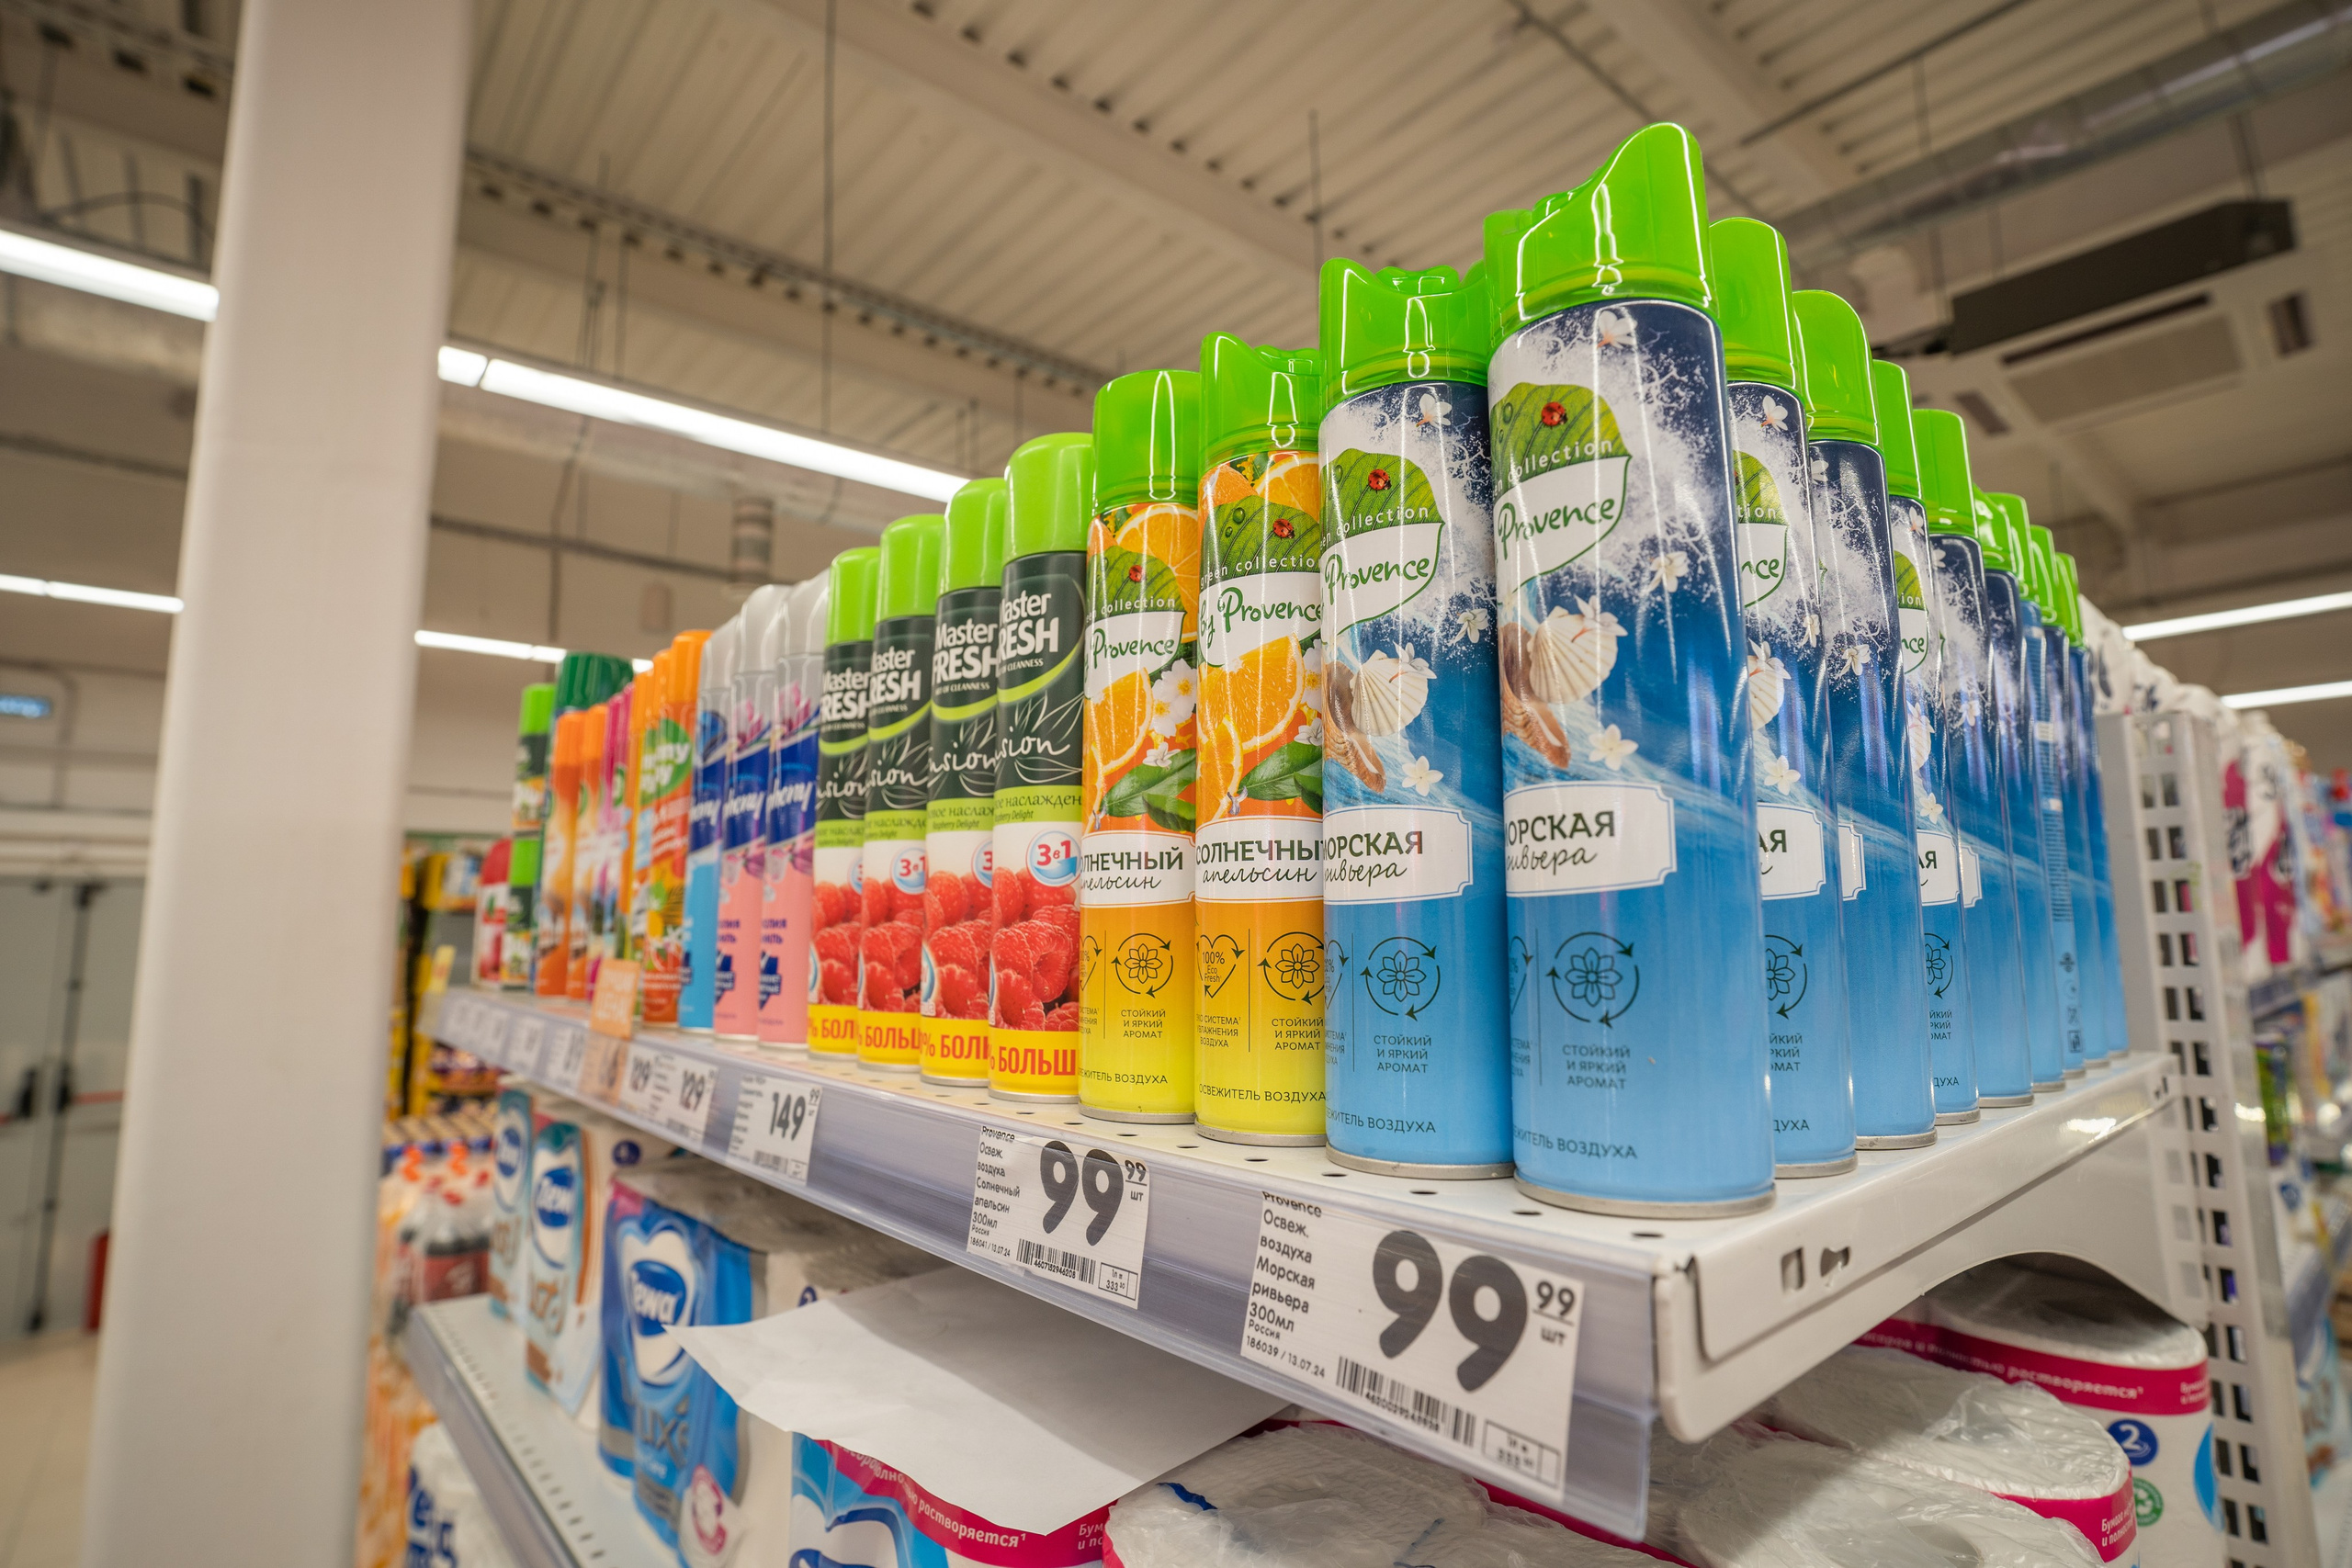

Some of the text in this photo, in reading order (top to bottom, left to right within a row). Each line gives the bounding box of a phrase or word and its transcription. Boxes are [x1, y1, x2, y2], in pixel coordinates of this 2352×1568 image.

[1508, 440, 1612, 482] collection
[1337, 506, 1429, 536] collection
[1498, 498, 1615, 560] Provence
[1236, 554, 1315, 572] collectio
[1324, 554, 1430, 605] Provence
[1101, 596, 1176, 615] collection
[934, 617, 999, 652] Master
[998, 616, 1059, 661] RESH
[1091, 628, 1175, 670] Provence
[869, 670, 922, 705] RESH
[1006, 794, 1082, 808] наслажден
[1506, 810, 1615, 846] ОРСКАЯ
[1081, 846, 1183, 873] ЛНЕЧНЫЙ
[1196, 840, 1323, 865] СОЛНЕЧНЫ
[1203, 867, 1317, 884] апельсин
[1202, 951, 1226, 964] 100%
[1206, 965, 1218, 975] Eco
[1120, 1009, 1166, 1018] СТОЙКИЙ
[1272, 1016, 1324, 1027] СТОЙКИЙ
[1929, 1010, 1952, 1019] ЙКИЙ
[821, 1018, 854, 1040] БОЛ
[1123, 1020, 1163, 1028] И ЯРКИЙ
[1123, 1030, 1163, 1039] АРОМАТ
[1200, 1036, 1229, 1048] ВОЗДУХА
[1274, 1028, 1321, 1039] И ЯРКИЙ
[1374, 1034, 1432, 1046] СТОЙКИЙ
[1770, 1032, 1803, 1044] ЙКИЙ
[1274, 1042, 1321, 1050] АРОМАТ
[1377, 1048, 1429, 1060] И ЯРКИЙ
[1562, 1044, 1631, 1058] СТОЙКИЙ
[998, 1046, 1076, 1076] БОЛЬШ
[1376, 1062, 1429, 1073] АРОМАТ
[1566, 1061, 1626, 1074] И ЯРКИЙ
[1114, 1073, 1168, 1085] ВОЗДУХА
[1566, 1075, 1626, 1089] АРОМАТ
[1933, 1077, 1960, 1089] ДУХА
[1198, 1083, 1326, 1104] ОСВЕЖИТЕЛЬ ВОЗДУХА
[770, 1091, 807, 1141] 149
[982, 1125, 1015, 1144] Provence
[1367, 1117, 1436, 1134] ВОЗДУХА
[1773, 1119, 1810, 1134] ДУХА
[979, 1142, 1003, 1159] Освеж.
[1556, 1138, 1638, 1159] ВОЗДУХА
[977, 1161, 1006, 1177] воздуха
[976, 1176, 1020, 1198] Солнечный
[1040, 1140, 1147, 1247] 99 99
[1130, 1190, 1144, 1201] шт
[974, 1196, 1010, 1213] апельсин
[1261, 1190, 1322, 1218] Provence
[972, 1212, 998, 1229] 300мл
[1263, 1208, 1309, 1238] Освеж.
[971, 1224, 989, 1236] Россия
[970, 1236, 988, 1249] 186041
[991, 1243, 1011, 1257] 13.07.24
[1260, 1235, 1312, 1264] воздуха
[1256, 1255, 1316, 1290] Морская
[1105, 1280, 1119, 1292] 333
[1251, 1281, 1309, 1314] ривьера
[1250, 1302, 1295, 1333] 300мл
[1373, 1230, 1575, 1394] 99 99
[1249, 1319, 1281, 1340] Россия
[1541, 1326, 1566, 1348] шт
[1247, 1336, 1279, 1357] 186039
[1288, 1353, 1325, 1379] 13.07.24
[2119, 1424, 2143, 1451] 2
[1079, 1523, 1103, 1538] Бум
